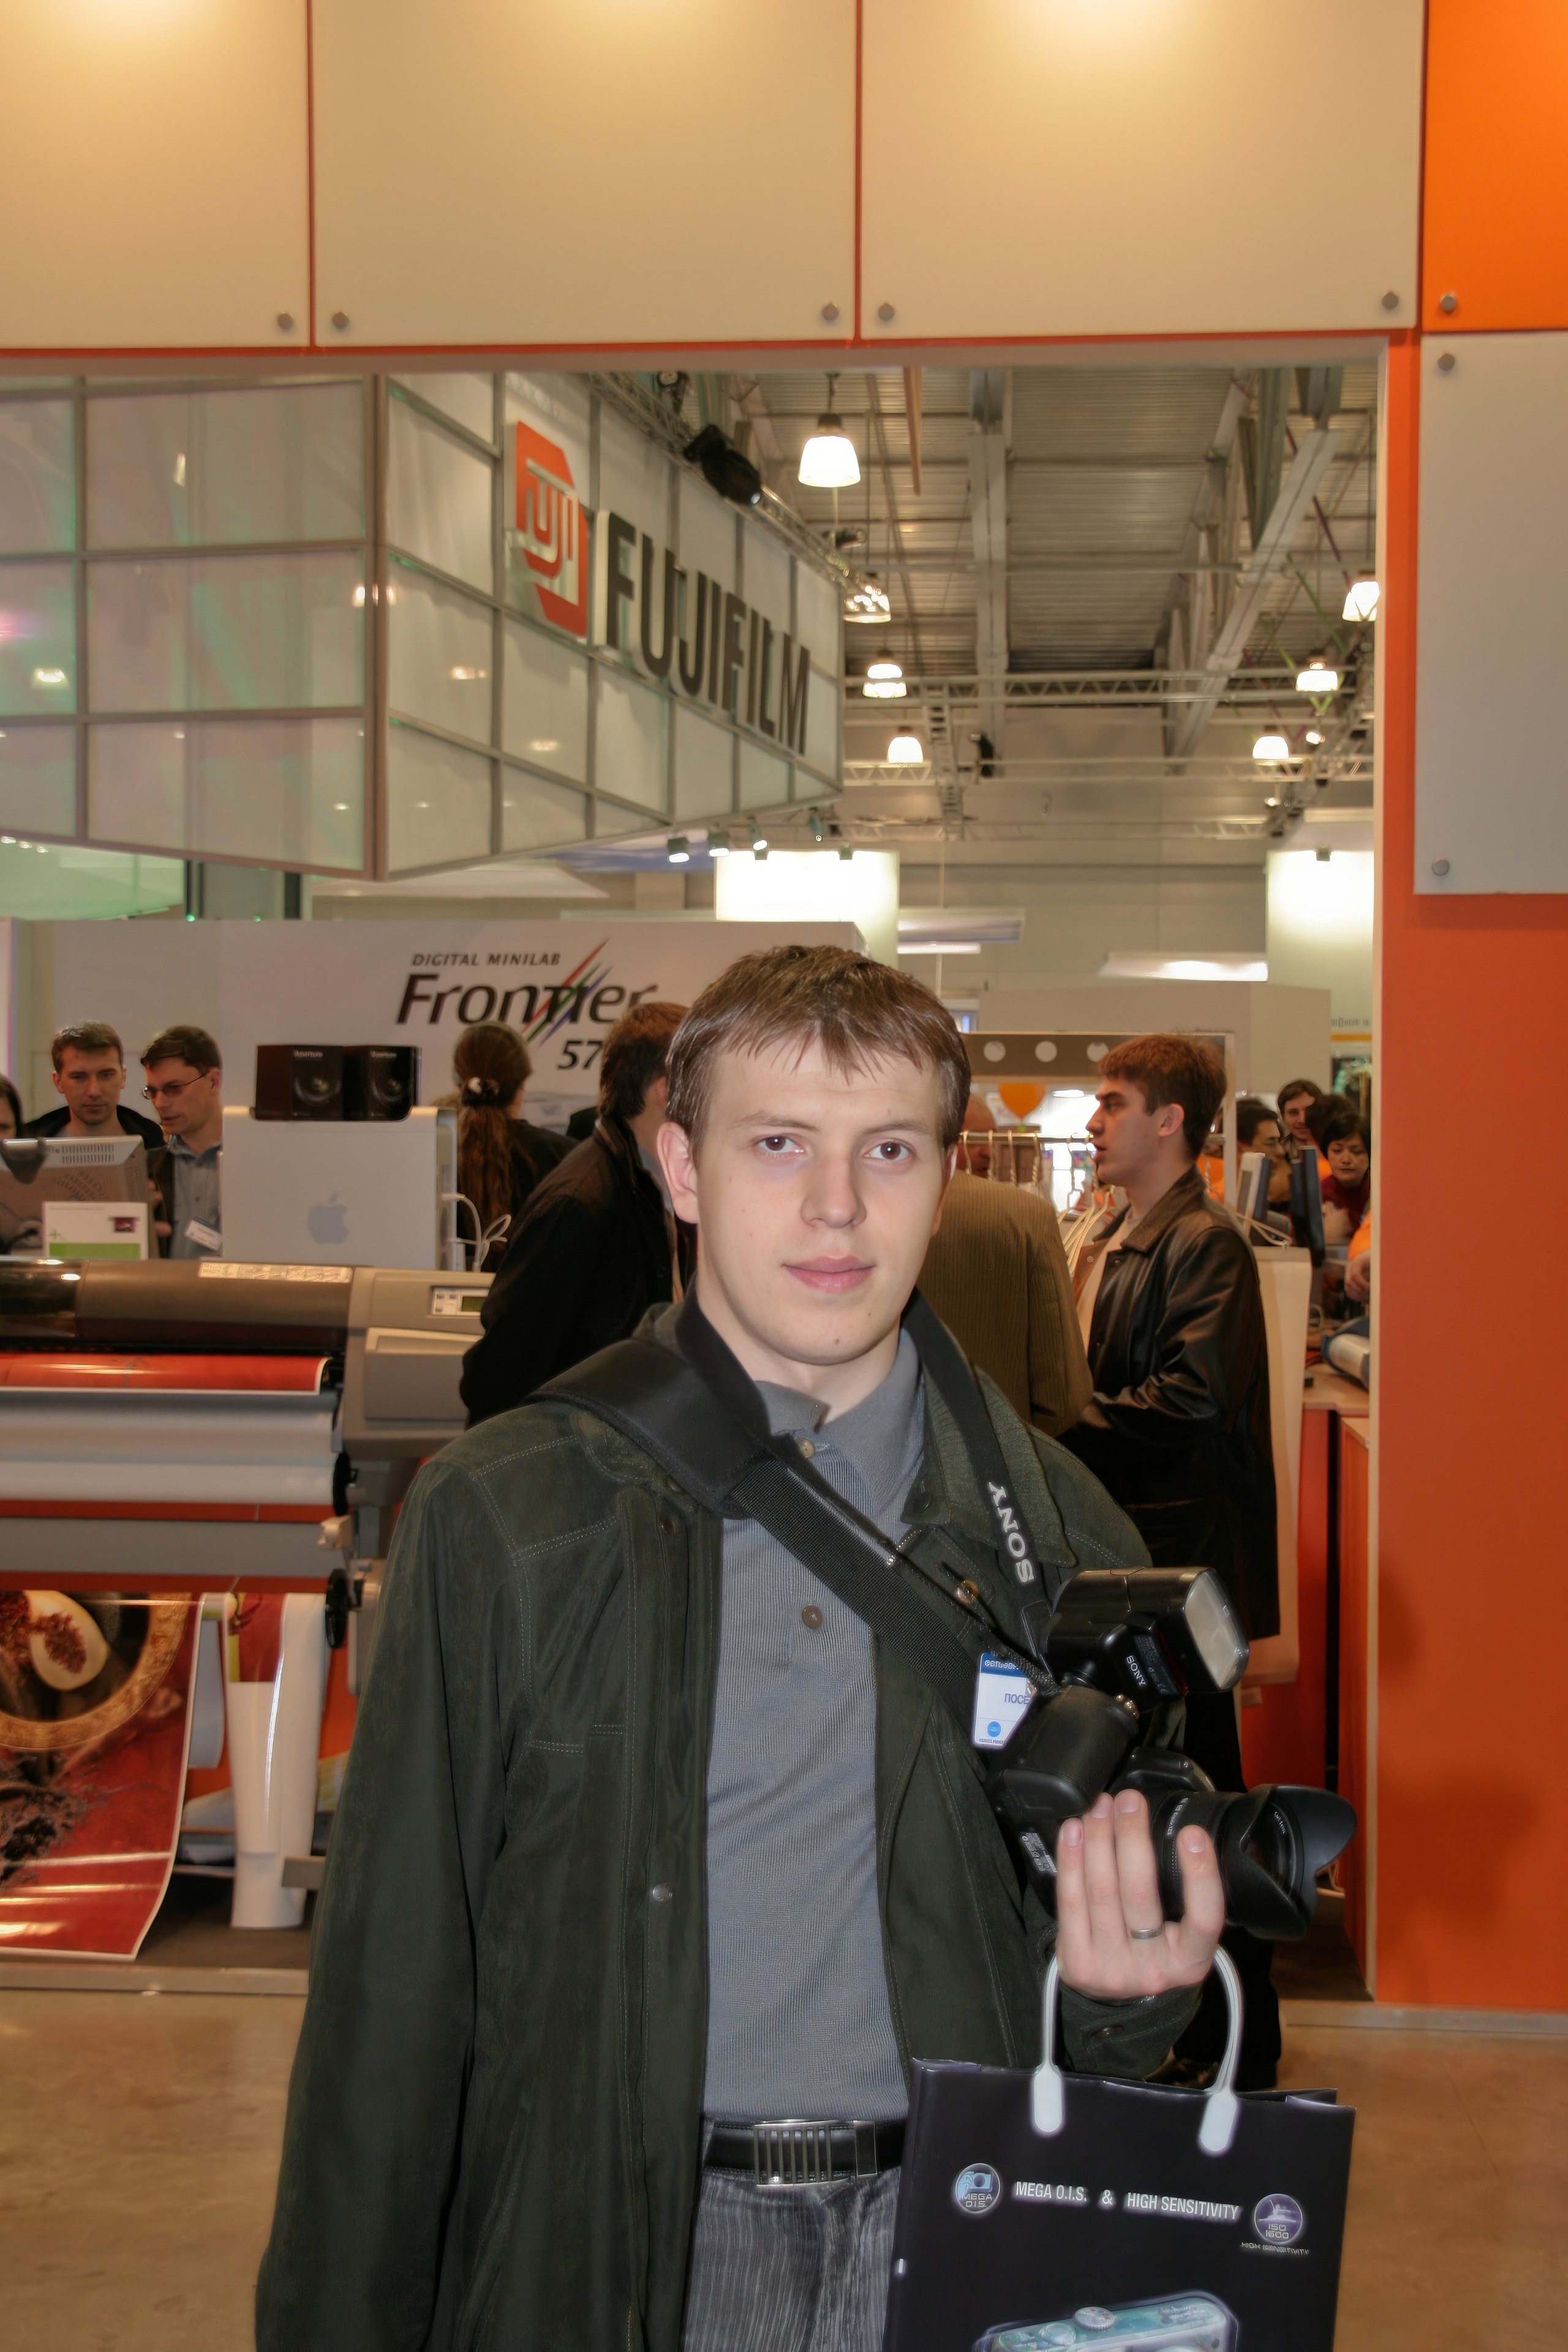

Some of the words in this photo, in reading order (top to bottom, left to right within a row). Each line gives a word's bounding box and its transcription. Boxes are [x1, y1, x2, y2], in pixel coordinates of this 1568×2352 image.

[604, 511, 810, 756] FUJIFILM
[412, 953, 479, 967] DIGITAL
[488, 953, 561, 966] MINILAB
[396, 973, 659, 1025] Frontier
[987, 1481, 1035, 1583] SONY
[1126, 1655, 1147, 1686] SONY
[1004, 1693, 1031, 1705] ПОСЕ
[1015, 2180, 1052, 2199] MEGA
[1101, 2189, 1114, 2205] &
[1127, 2192, 1158, 2210] HIGH
[1161, 2196, 1239, 2220] SENSITIVITY
